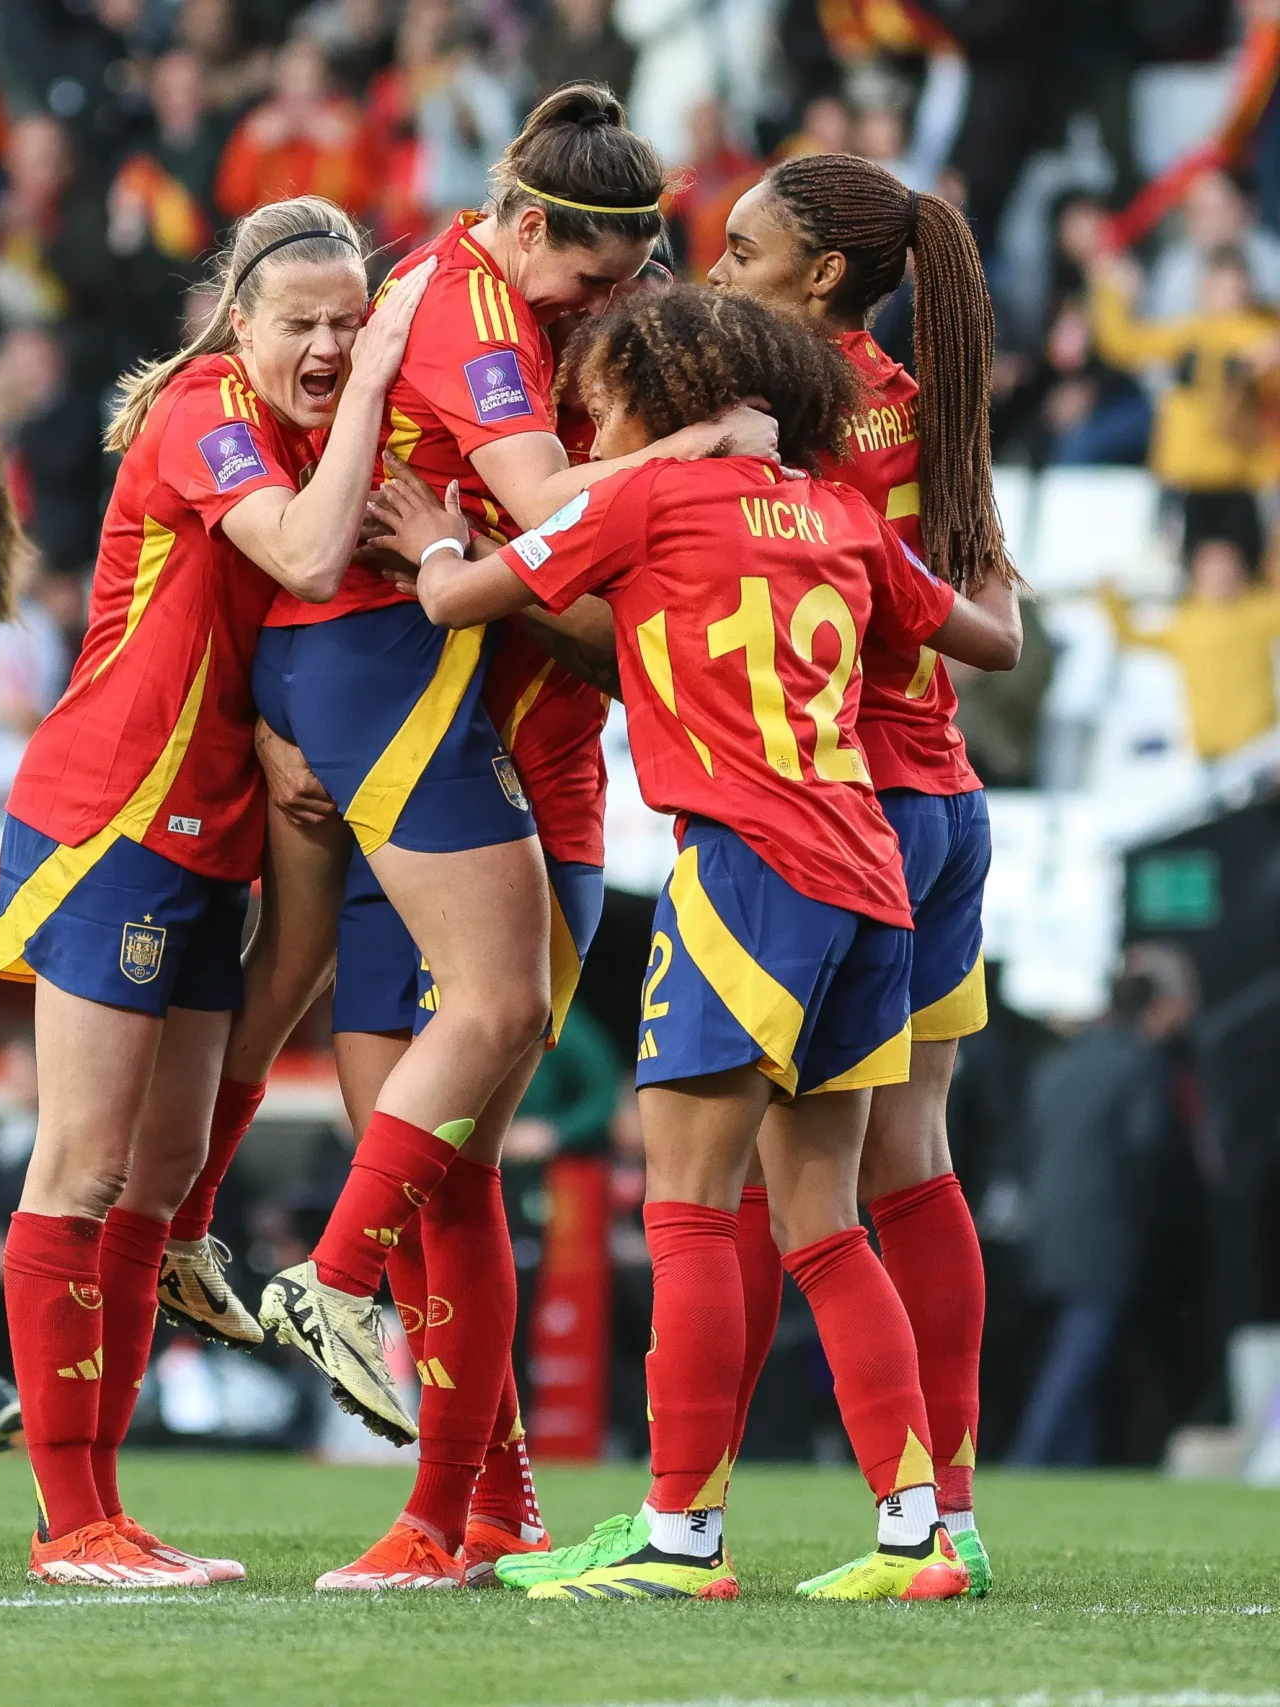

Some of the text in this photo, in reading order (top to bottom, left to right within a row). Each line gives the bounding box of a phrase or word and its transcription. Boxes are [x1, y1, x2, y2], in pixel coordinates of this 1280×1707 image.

[479, 389, 521, 407] EUROPEAN
[481, 395, 524, 412] QUALIFIERS
[217, 455, 255, 478] EUROPEAN
[219, 461, 258, 484] QUALIFIERS
[740, 496, 829, 545] VICKY
[707, 576, 872, 785] 12
[641, 930, 674, 1022] 2
